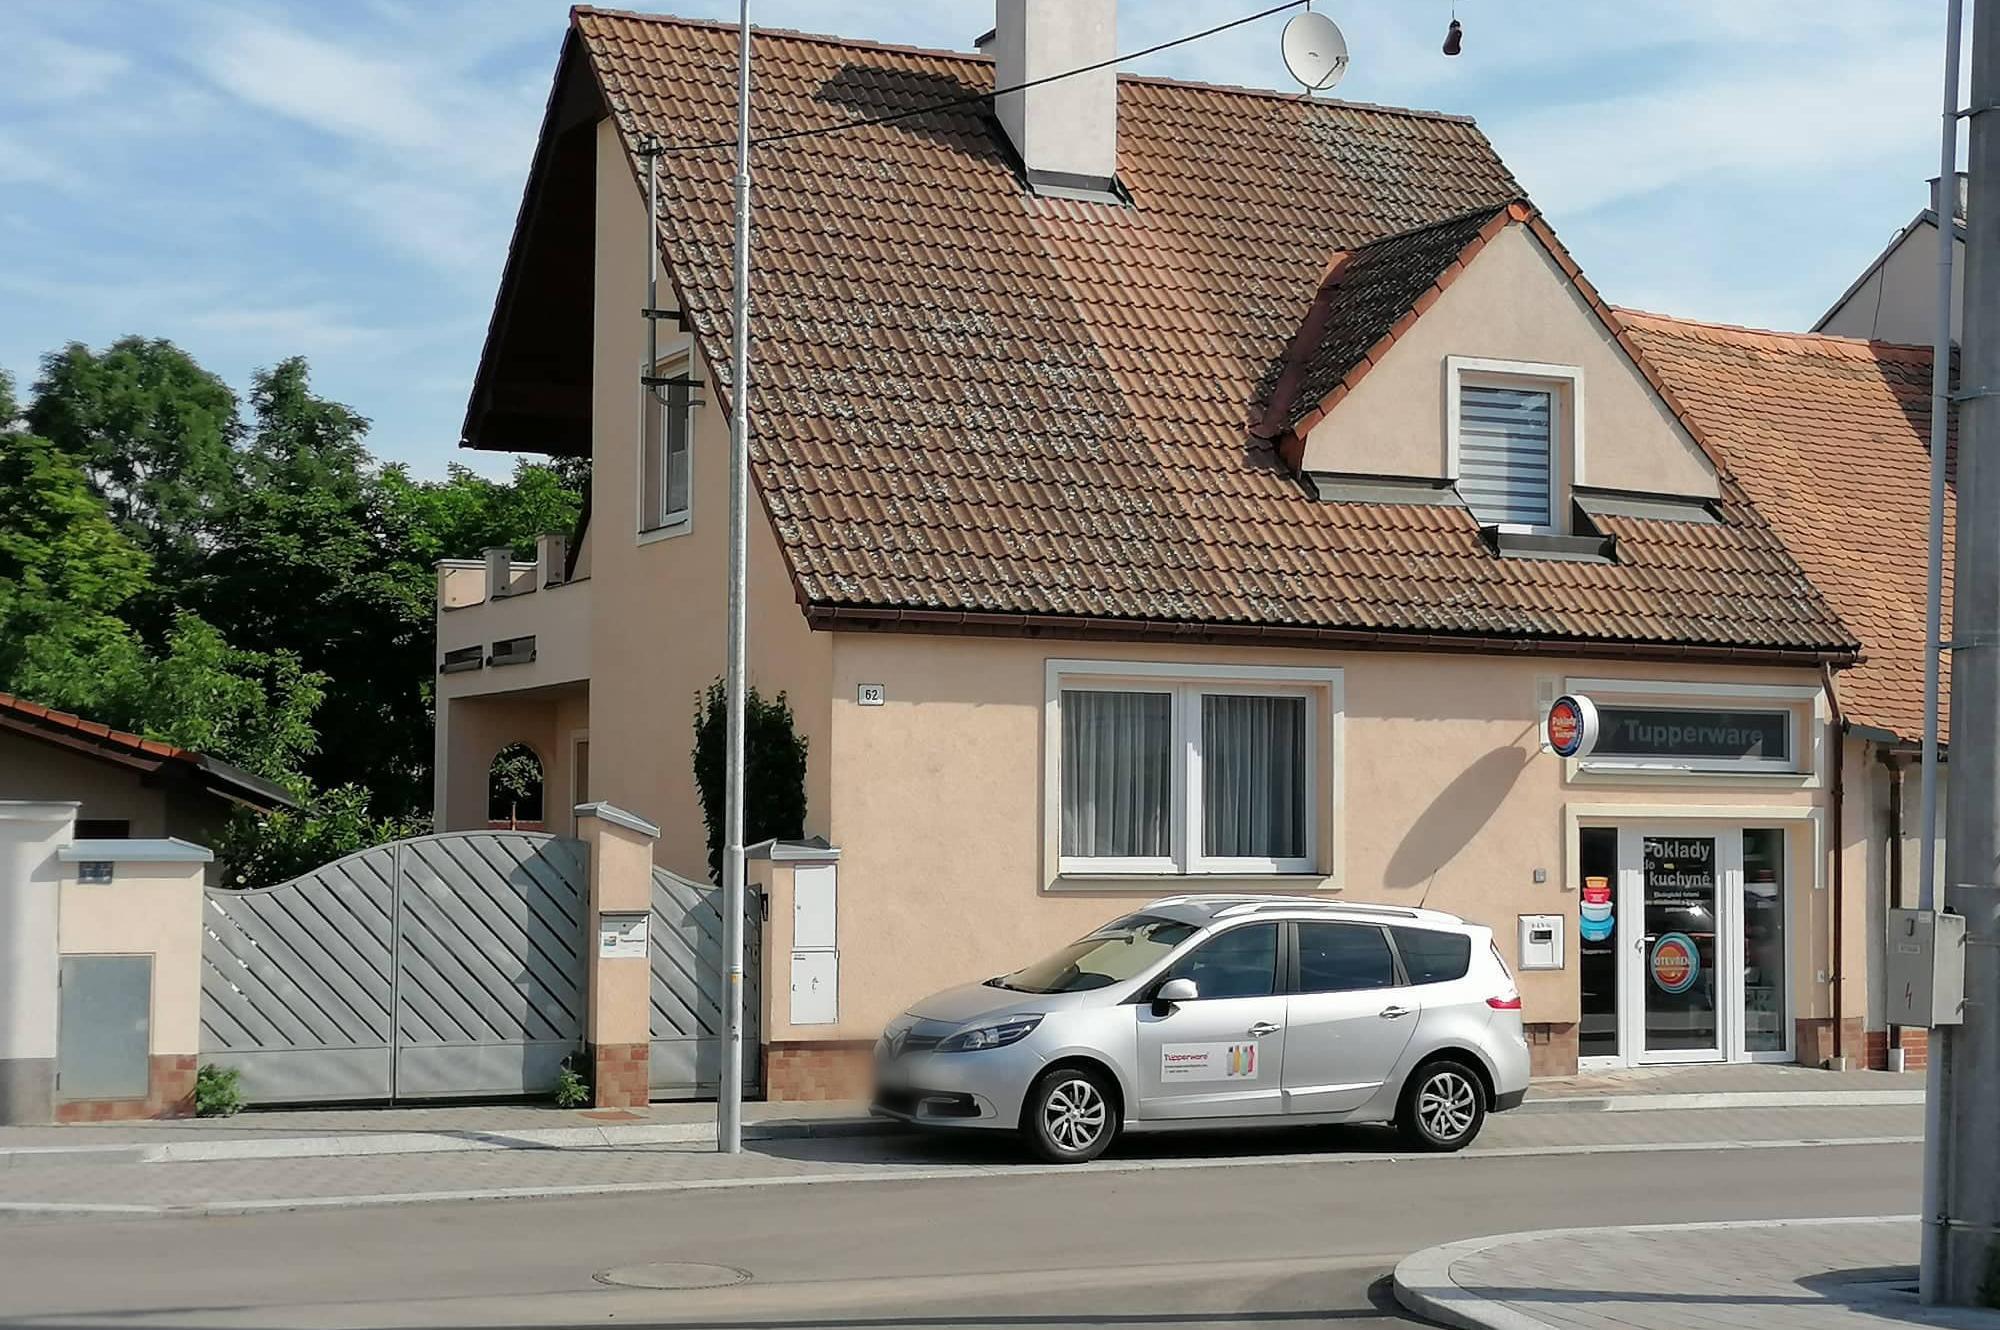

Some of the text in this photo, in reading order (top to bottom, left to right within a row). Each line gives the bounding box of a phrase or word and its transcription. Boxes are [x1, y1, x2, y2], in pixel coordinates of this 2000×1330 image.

[865, 689, 878, 700] 62
[1624, 719, 1763, 747] Tupperware
[1644, 840, 1710, 861] Poklady
[1649, 871, 1710, 888] kuchyně
